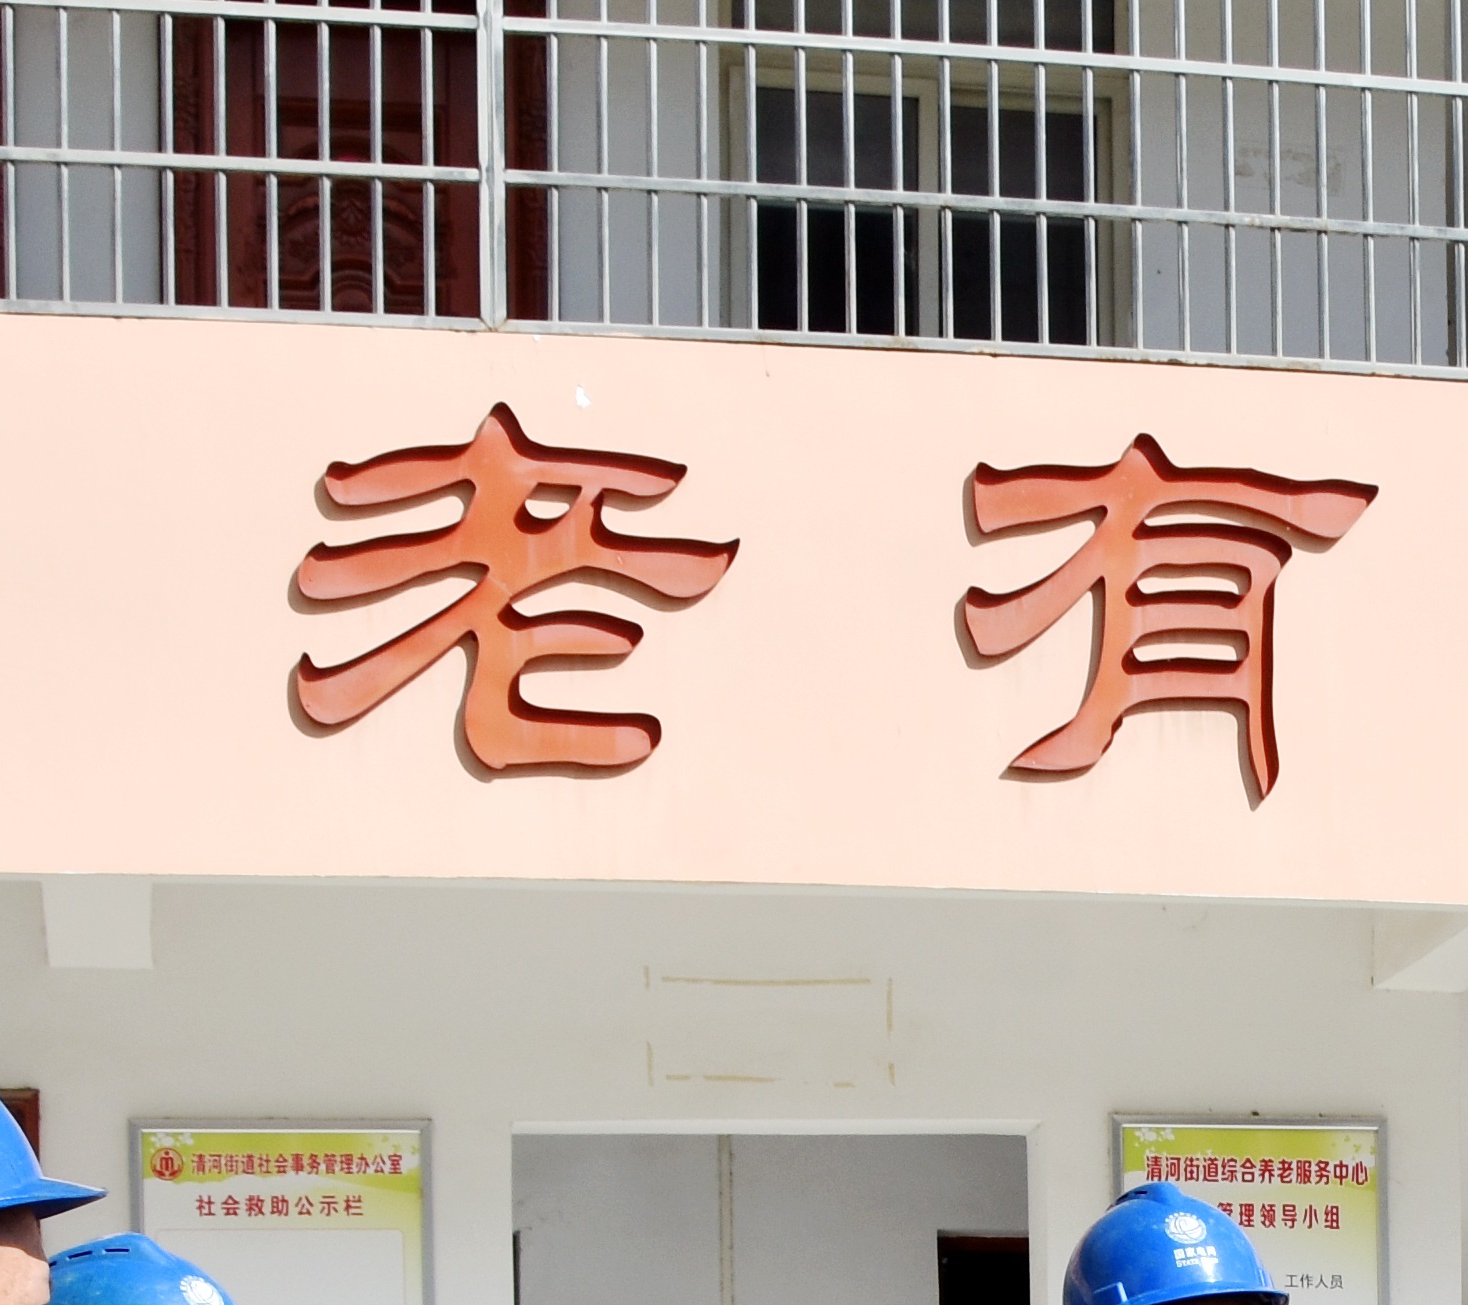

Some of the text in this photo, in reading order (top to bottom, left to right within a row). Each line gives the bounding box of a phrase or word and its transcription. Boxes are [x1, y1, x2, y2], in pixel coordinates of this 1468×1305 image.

[191, 1153, 403, 1175] 清河街道社会事务管理办公室
[1146, 1155, 1369, 1186] 清河街道综合养老服务中心
[196, 1195, 364, 1216] 社会救助公示栏
[1285, 1274, 1344, 1290] 工作人员
